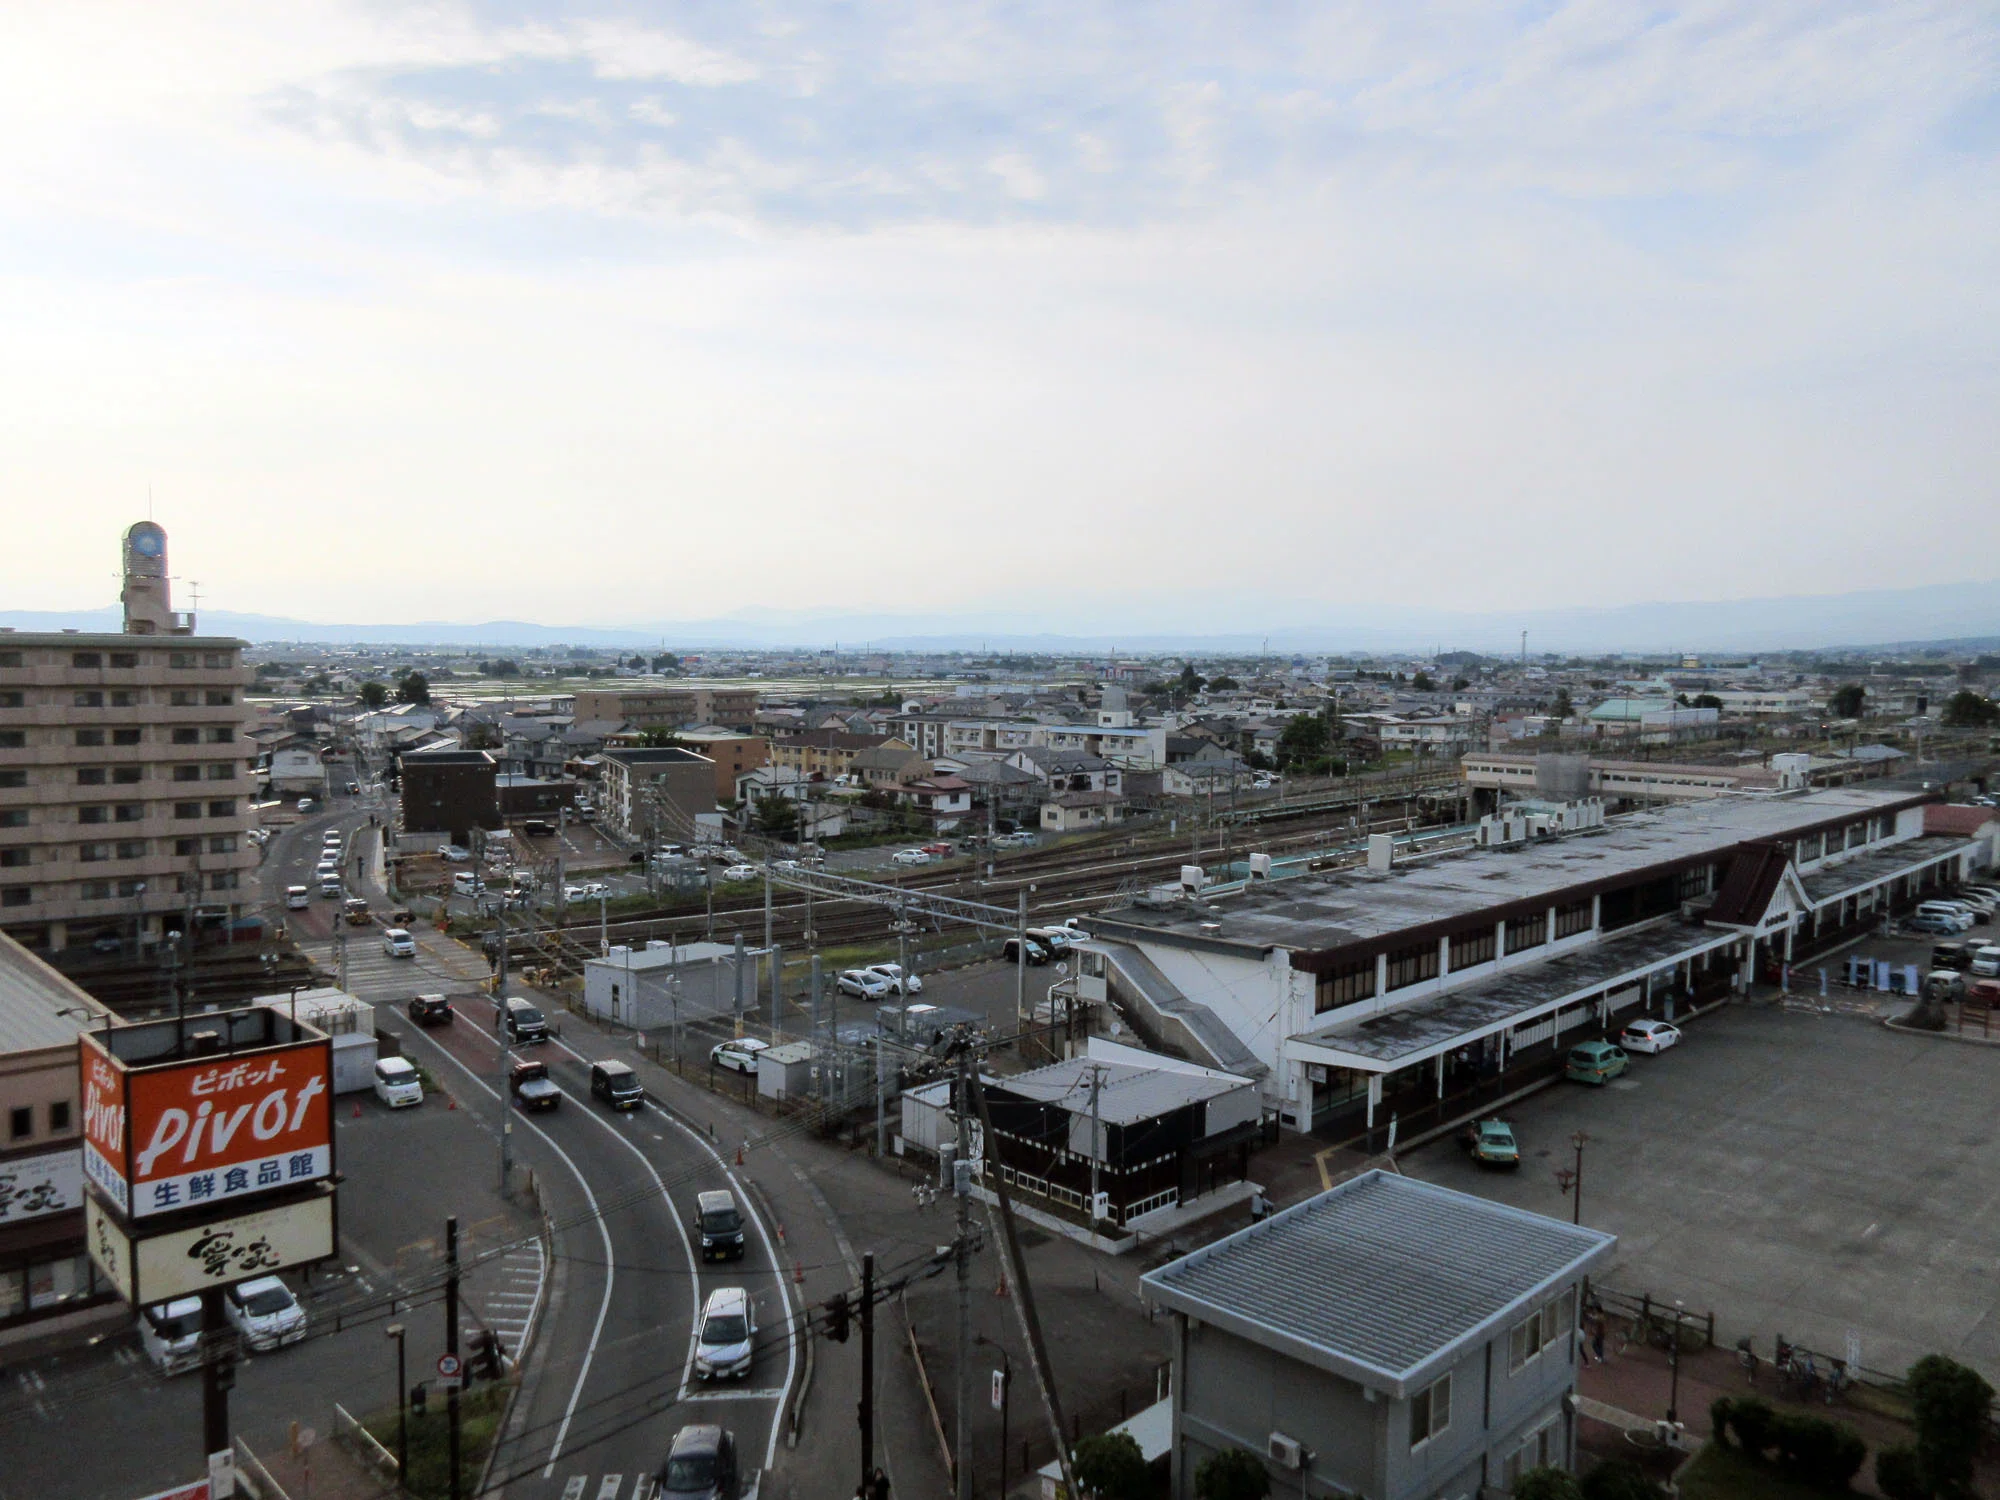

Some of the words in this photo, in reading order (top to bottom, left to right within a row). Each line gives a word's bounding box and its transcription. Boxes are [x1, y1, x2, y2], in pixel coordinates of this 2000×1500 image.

[191, 1060, 287, 1096] ピボット
[154, 1153, 314, 1208] 生鮮食品館
